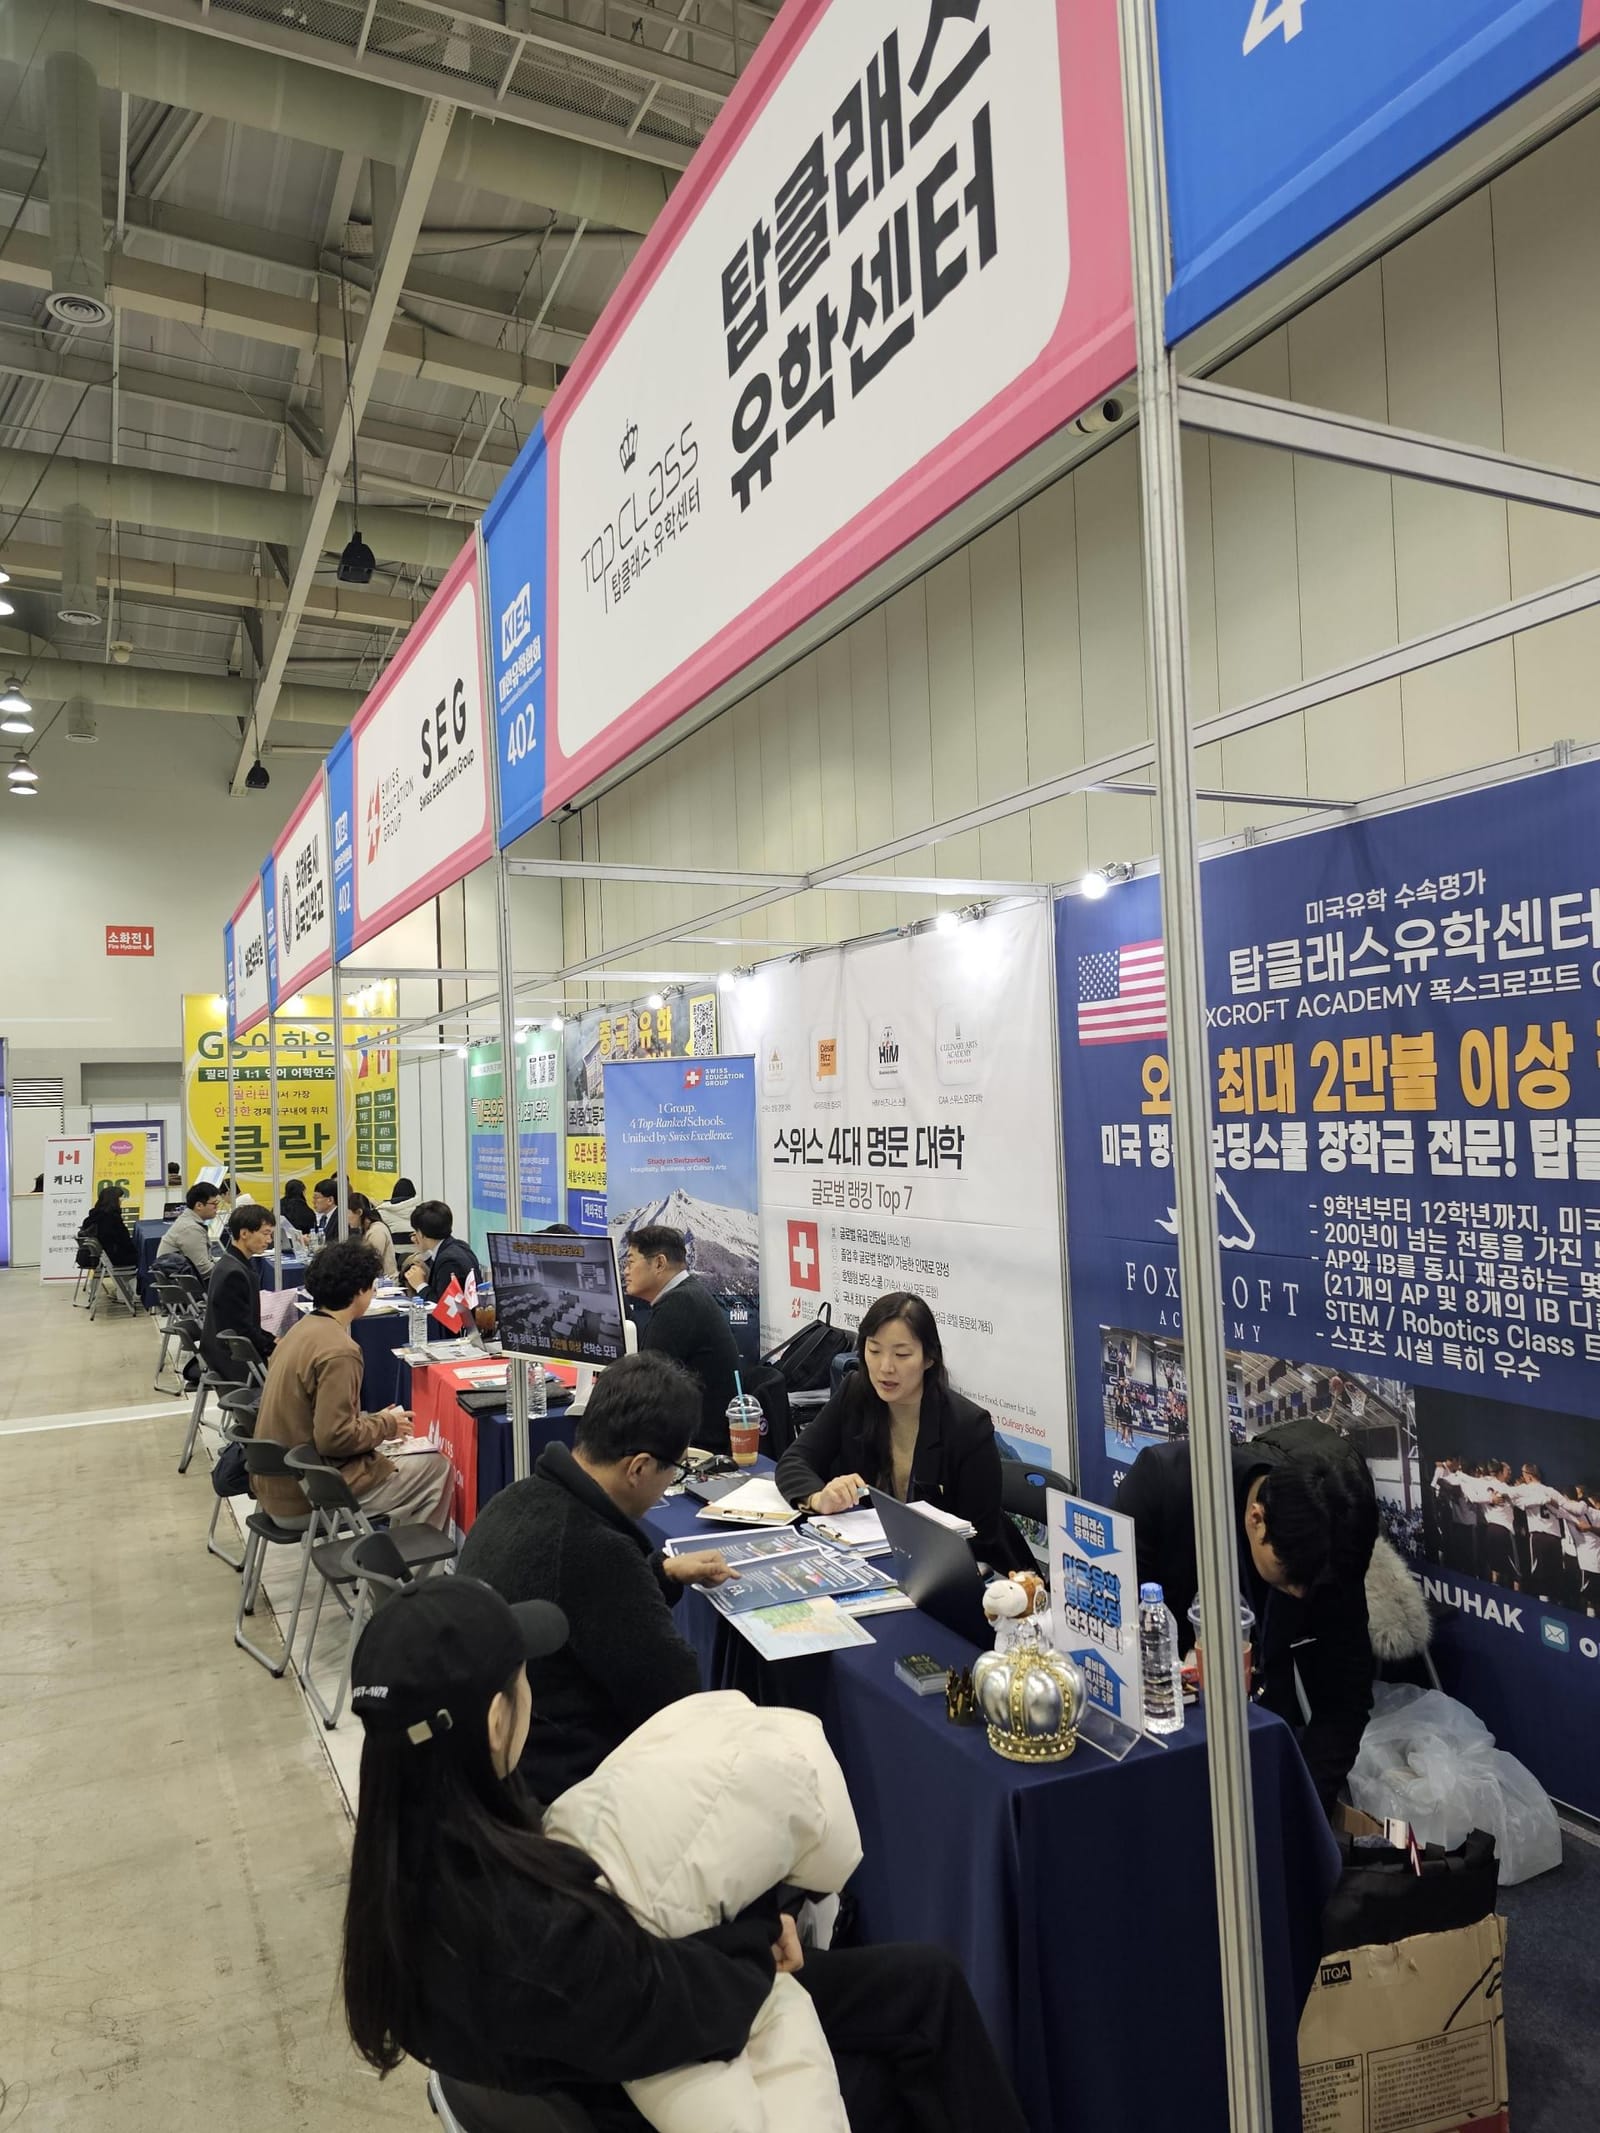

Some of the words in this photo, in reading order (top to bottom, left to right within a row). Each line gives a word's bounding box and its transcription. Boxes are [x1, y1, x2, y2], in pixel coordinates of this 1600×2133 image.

[721, 0, 992, 379] 탑클래스
[730, 99, 998, 514] 유학센터
[611, 540, 652, 604] 탑클래스
[654, 477, 701, 558] 유학센터
[502, 584, 531, 657] KIEA
[421, 678, 466, 779] SEG
[507, 703, 537, 766] 402
[381, 768, 400, 799] SWISS
[382, 776, 414, 821] EDUCATION
[419, 791, 434, 812] Swiss
[432, 764, 457, 800] Education
[457, 748, 475, 775] Group
[383, 813, 402, 842] GROUP
[1305, 888, 1388, 925] 미국유학
[1393, 868, 1487, 911] 수속명가
[108, 932, 142, 945] 소화전
[1228, 886, 1600, 996] 탑클래스유학센터
[1206, 997, 1290, 1028] XCROFT
[1296, 982, 1423, 1020] ACADEMY
[1429, 963, 1582, 1004] 폭스크로프트
[600, 1016, 630, 1056] 중국
[638, 1004, 673, 1049] 유학
[245, 1069, 260, 1078] 1:1
[705, 1067, 728, 1075] SWISS
[1141, 1053, 1170, 1116] 오
[1217, 1042, 1297, 1116] 최대
[1309, 1030, 1438, 1113] 2만불
[1458, 1020, 1576, 1111] 이상
[639, 1117, 687, 1130] Top-Ranked
[688, 1115, 727, 1127] Schools.
[664, 1103, 697, 1115] Group.
[215, 1122, 330, 1173] 클락
[622, 1132, 655, 1144] Unified
[656, 1133, 668, 1145] by
[668, 1131, 690, 1141] Swiss
[690, 1129, 734, 1141] Excellence.
[774, 1127, 824, 1164] 스위스
[828, 1126, 861, 1167] 4대
[866, 1126, 909, 1168] 명문
[915, 1124, 965, 1170] 대학
[1100, 1123, 1142, 1168] 미국
[1317, 1119, 1414, 1175] 장학금
[1427, 1119, 1518, 1178] 전문!
[812, 1179, 846, 1208] 글로벌
[848, 1180, 873, 1210] 랭킹
[875, 1183, 901, 1215] Top
[903, 1185, 913, 1210] 7
[1323, 1194, 1412, 1224] 9학년부터
[1421, 1200, 1548, 1233] 12학년까지,
[840, 1226, 856, 1241] 글로벌
[857, 1228, 868, 1243] 유급
[869, 1230, 887, 1246] 인턴십
[1324, 1222, 1399, 1250] 200년이
[1407, 1228, 1448, 1256] 넘는
[1456, 1230, 1524, 1263] 전통을
[1534, 1236, 1583, 1268] 가진
[841, 1247, 851, 1263] 졸업
[853, 1249, 859, 1264] 후
[860, 1250, 876, 1266] 글로벌
[896, 1255, 914, 1272] 가능한
[916, 1258, 935, 1274] 인재로
[936, 1261, 950, 1278] 양성
[860, 1271, 870, 1287] 보딩
[871, 1274, 883, 1289] 스쿨
[1325, 1249, 1371, 1276] AP와
[1376, 1255, 1416, 1279] IB를
[1423, 1257, 1465, 1284] 동시
[1475, 1261, 1569, 1296] 제공하는
[1125, 1261, 1300, 1318] FOXOFT
[1324, 1270, 1393, 1304] (21개의
[1399, 1282, 1430, 1307] AP
[1436, 1285, 1457, 1312] 및
[1464, 1290, 1526, 1322] 8개의
[1535, 1299, 1561, 1324] IB
[1325, 1299, 1379, 1327] STEM
[1402, 1309, 1501, 1346] Robotics
[1506, 1323, 1576, 1358] Class
[1330, 1325, 1388, 1357] 스포츠
[1394, 1335, 1435, 1366] 시설
[1442, 1343, 1486, 1374] 특히
[1494, 1350, 1542, 1384] 우수
[999, 1398, 1017, 1410] Career
[1001, 1417, 1024, 1432] Culinary
[1024, 1423, 1046, 1438] School
[1073, 1511, 1104, 1536] 탑클래스
[1074, 1525, 1106, 1550] 유학센터
[1321, 1969, 1350, 1983] ITQA
